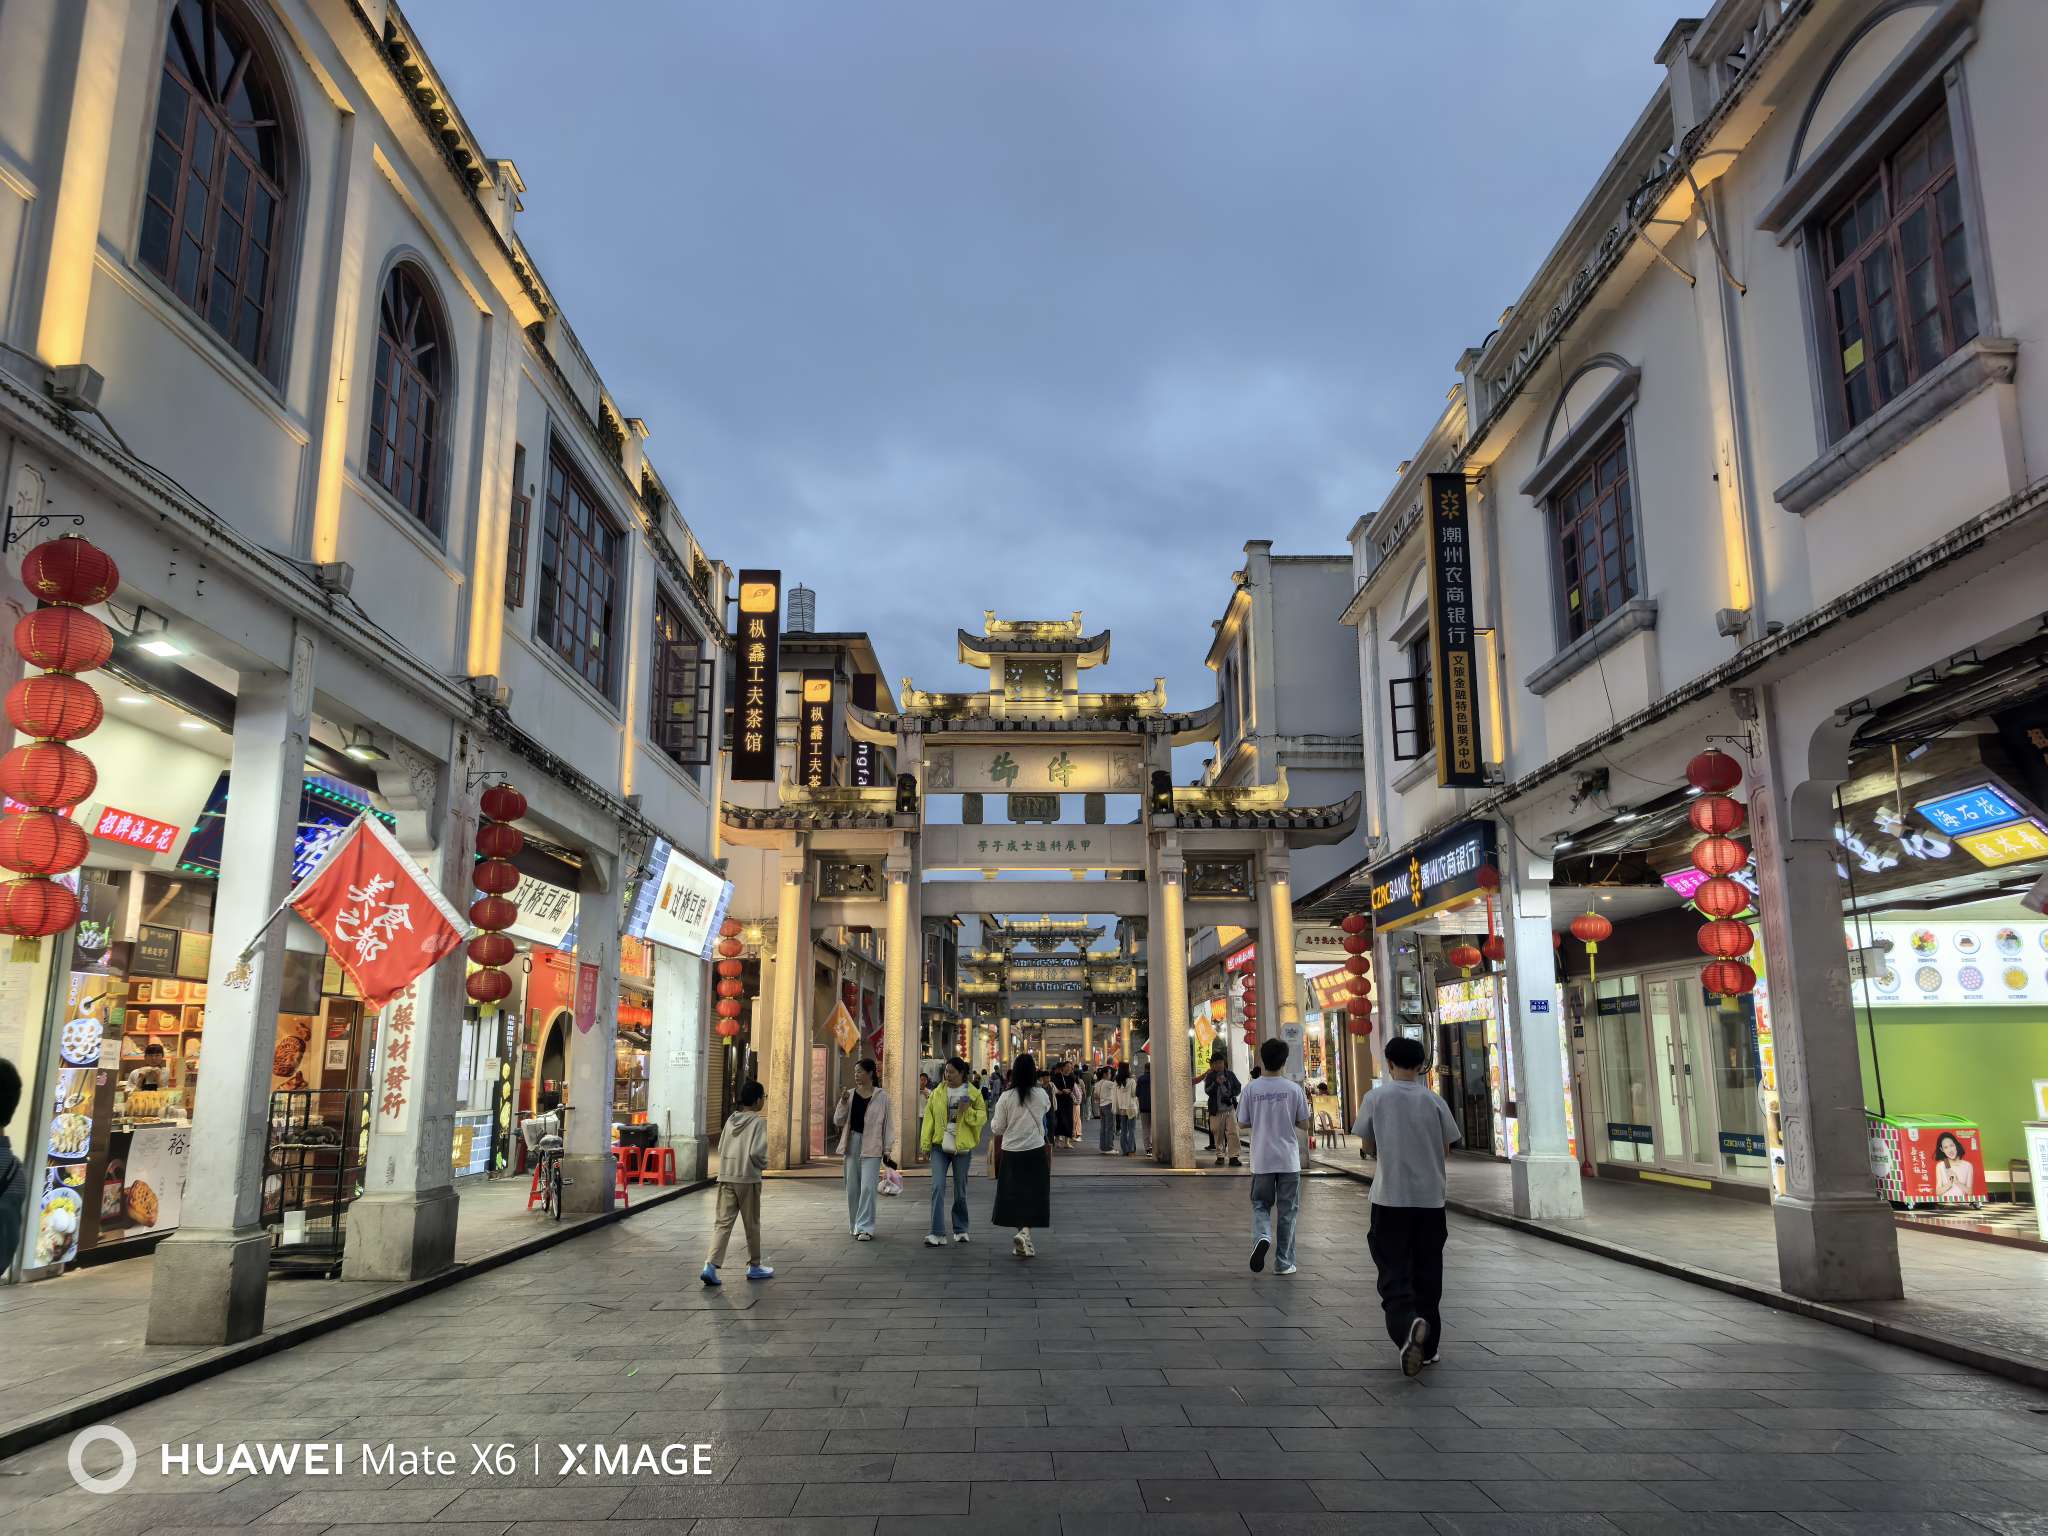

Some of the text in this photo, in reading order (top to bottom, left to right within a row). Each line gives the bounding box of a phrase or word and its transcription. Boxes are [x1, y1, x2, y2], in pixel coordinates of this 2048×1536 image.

[1442, 527, 1467, 645] 潮州农商银行
[1453, 654, 1471, 770] 文旅金融特色服务中心
[98, 811, 174, 851] 招牌海石花
[1371, 840, 1477, 911] CZRCBANK 潮州农商银行
